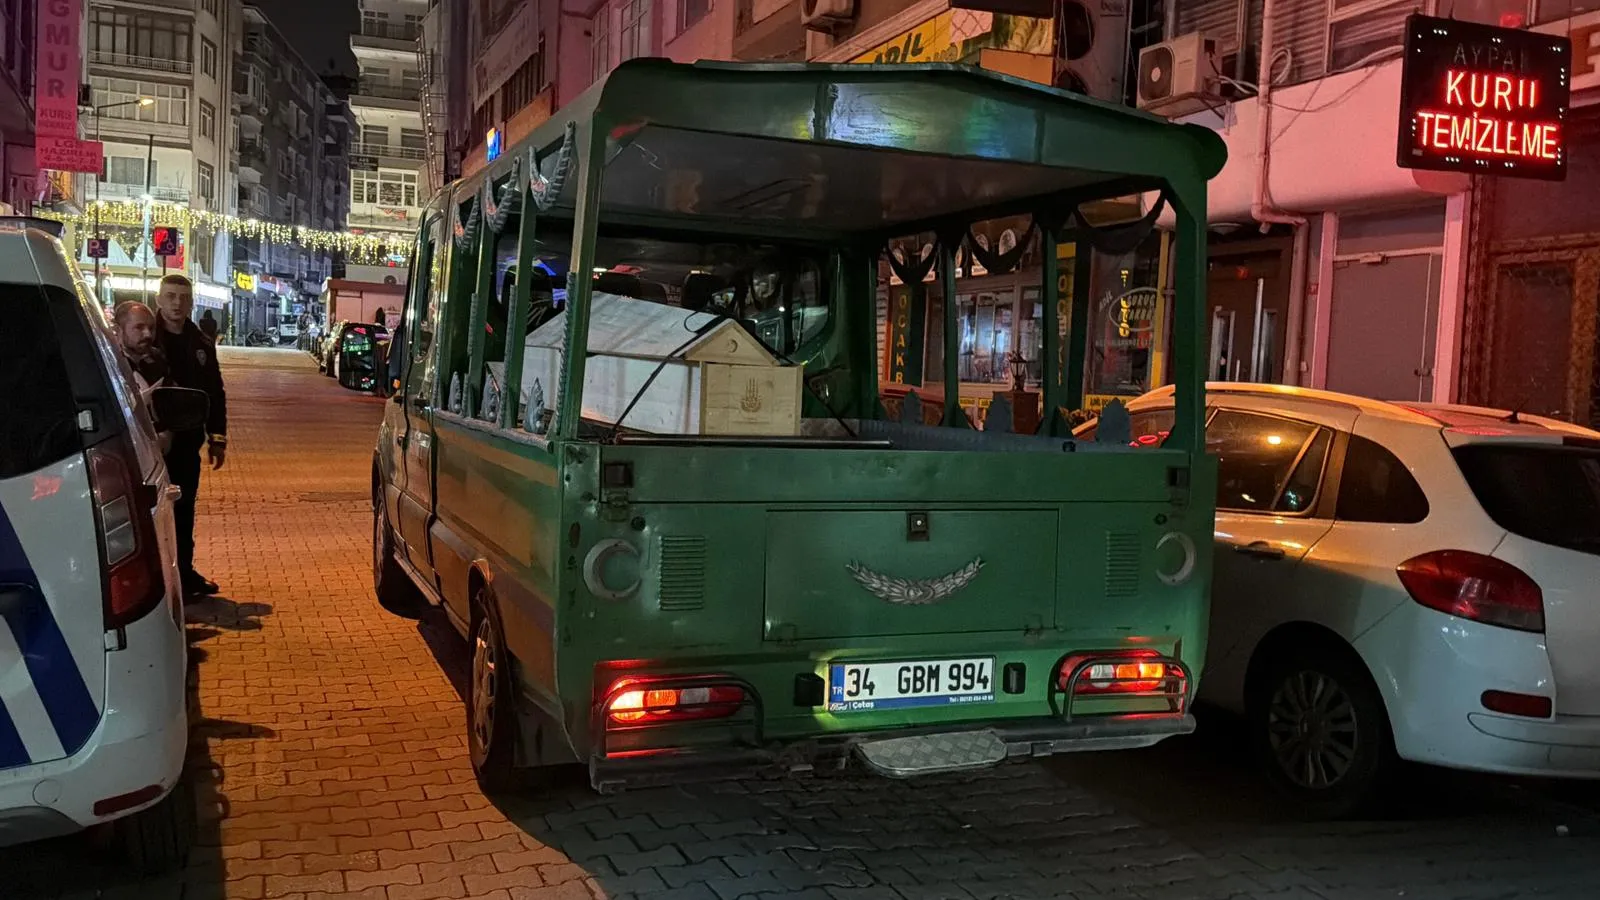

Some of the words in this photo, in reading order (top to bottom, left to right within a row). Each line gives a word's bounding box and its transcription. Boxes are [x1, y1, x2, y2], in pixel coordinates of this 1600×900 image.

[1417, 111, 1557, 160] TEMİZLEME
[832, 686, 843, 696] TR
[846, 668, 876, 698] 34
[897, 664, 940, 695] GBM
[948, 662, 990, 692] 994
